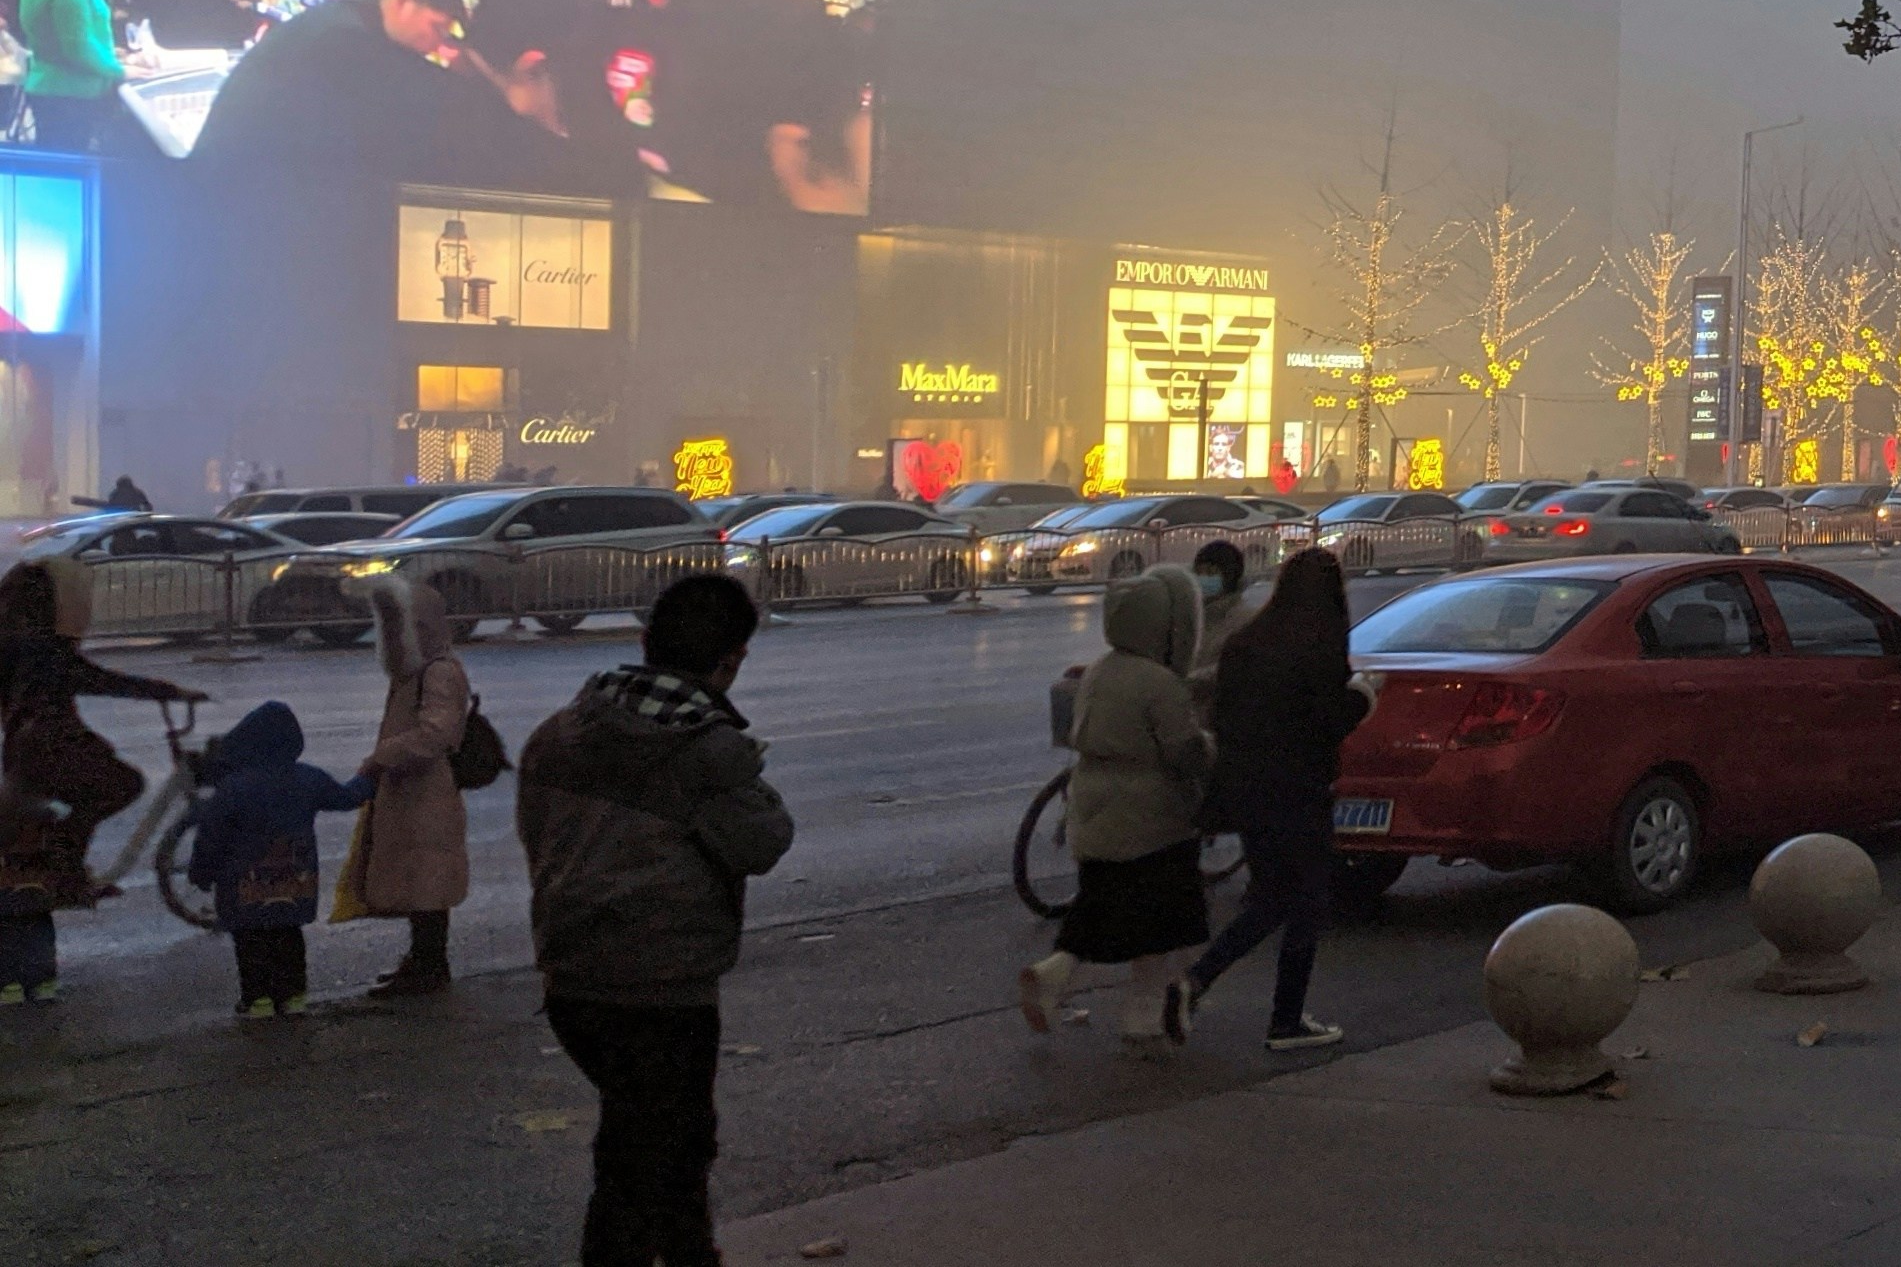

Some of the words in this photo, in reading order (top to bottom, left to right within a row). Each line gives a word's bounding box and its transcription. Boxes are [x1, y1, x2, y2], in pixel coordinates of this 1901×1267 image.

[523, 259, 598, 285] Cartier
[1116, 260, 1190, 286] EMPORIO
[1209, 267, 1268, 291] ARMANI
[1286, 353, 1314, 367] KARL
[898, 363, 998, 393] MaxMara
[520, 418, 596, 444] Cartier
